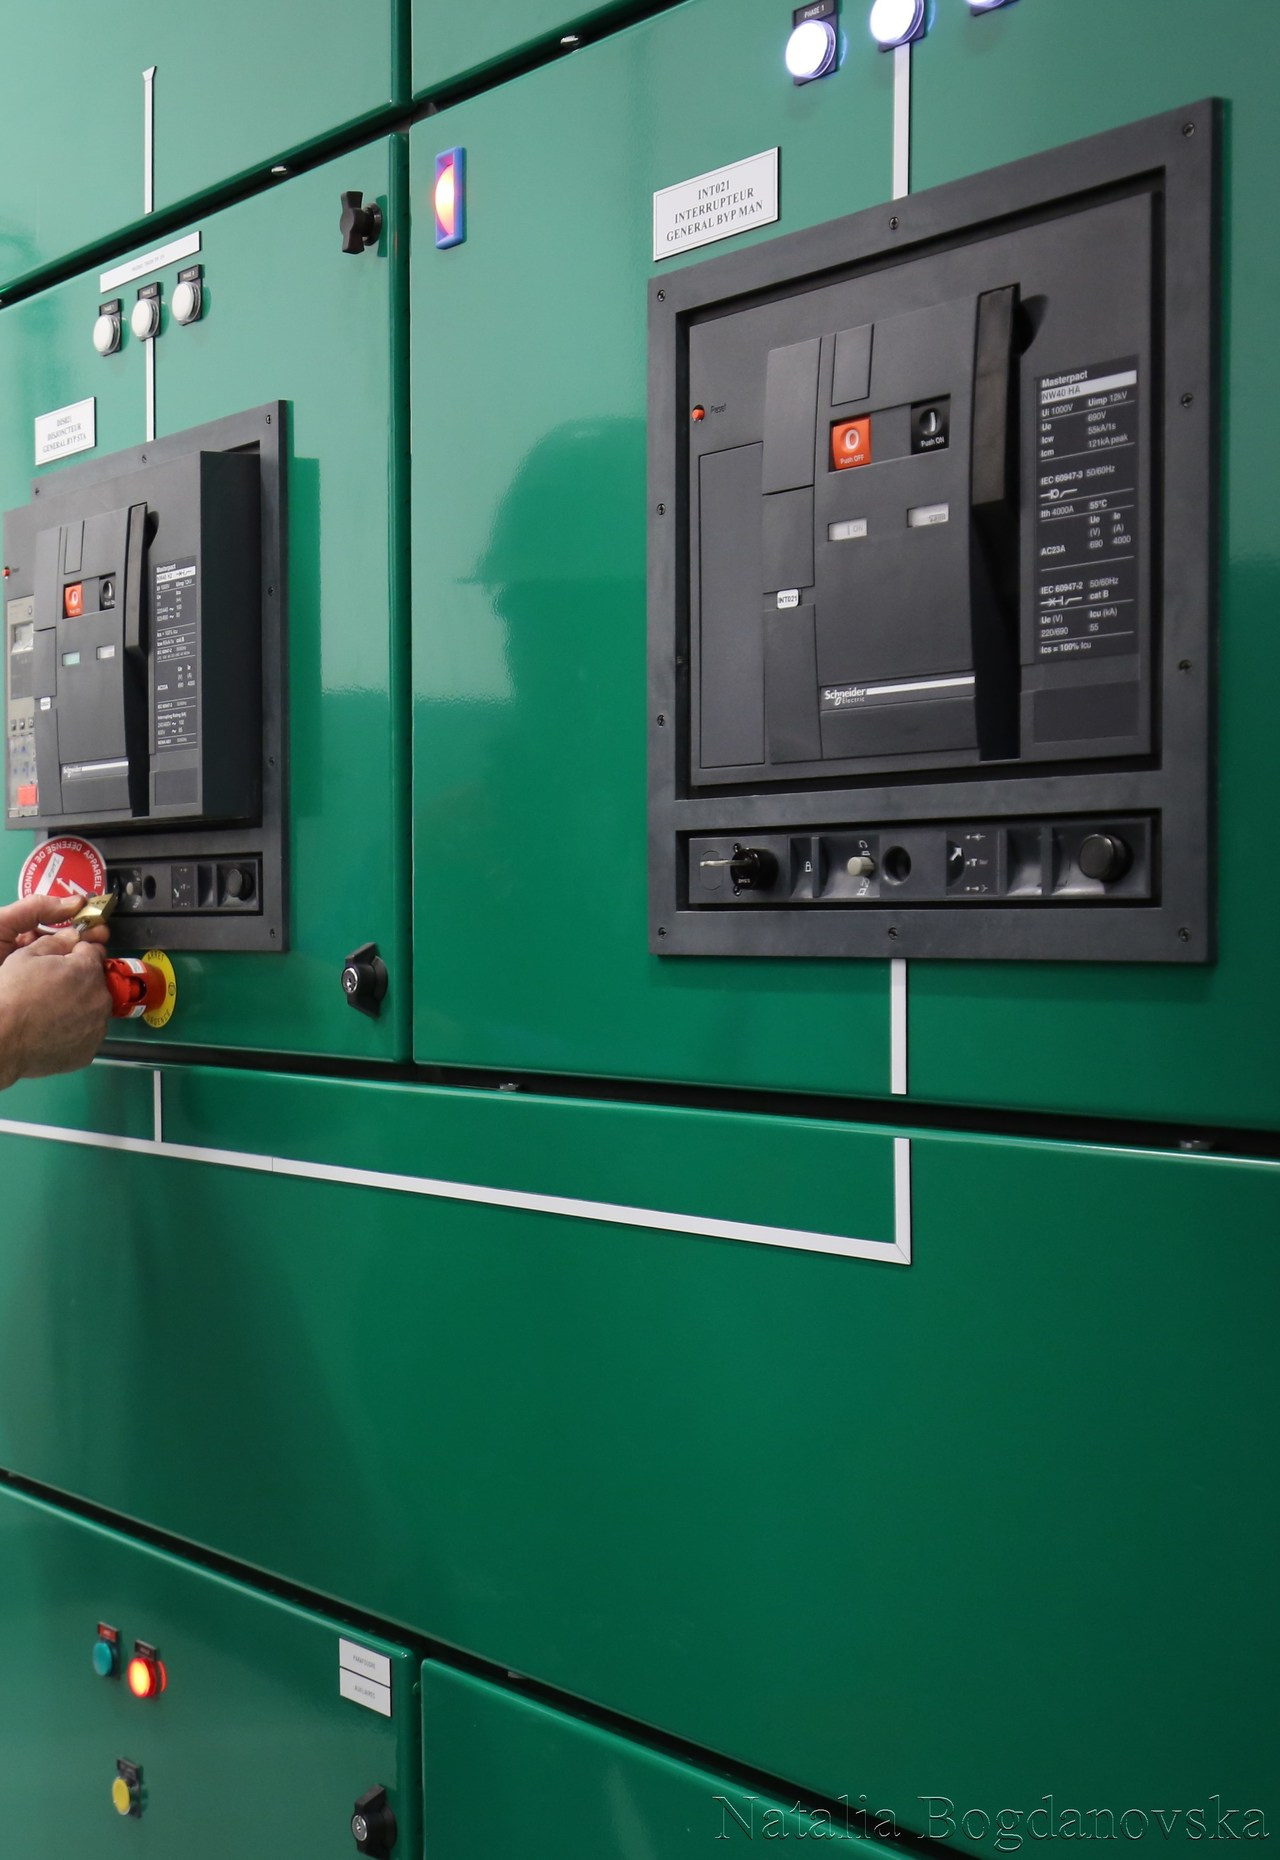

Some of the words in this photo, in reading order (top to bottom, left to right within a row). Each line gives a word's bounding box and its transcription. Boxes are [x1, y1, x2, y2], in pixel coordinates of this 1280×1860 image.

[804, 7, 820, 18] PHASE
[698, 180, 730, 200] INT021
[675, 188, 754, 224] INTERRUPTEUR
[666, 217, 714, 242] GENERAL
[716, 209, 736, 225] BYP
[739, 200, 763, 216] MAN
[1042, 370, 1088, 388] Masterpact
[1042, 389, 1066, 401] NW40
[1068, 386, 1081, 395] HA
[1042, 409, 1050, 417] Ui
[1051, 404, 1074, 415] 1000V
[1088, 397, 1108, 407] Uimp
[1110, 391, 1128, 402] 12kV
[1042, 423, 1051, 431] Ue
[1088, 412, 1107, 421] 690V
[1088, 423, 1116, 435] 55kA/1s
[921, 437, 935, 448] Push
[935, 436, 945, 445] ON
[840, 456, 854, 465] Push
[854, 454, 865, 463] OFF
[1041, 449, 1054, 457] Icm
[1040, 476, 1054, 486] IEC
[1055, 471, 1083, 483] 60947-3
[1086, 465, 1115, 477] 50/60Hz
[1052, 505, 1074, 515] 4000A
[1089, 499, 1108, 509] 55°C
[1090, 516, 1100, 524] Ue
[1089, 528, 1101, 538] (V)
[1113, 523, 1124, 533] (A)
[1090, 539, 1104, 549] 690
[1113, 535, 1131, 545] 4000
[1040, 545, 1066, 556] AC23A
[1041, 586, 1054, 595] IEC
[1055, 582, 1083, 593] 60947-2
[1090, 577, 1119, 588] 50/60Hz
[778, 595, 798, 604] INT021
[1090, 591, 1101, 600] cat
[1103, 590, 1109, 598] B
[1041, 616, 1052, 624] Ue
[1052, 614, 1063, 623] (V)
[1090, 610, 1102, 619] Icu
[1103, 607, 1118, 618] (kA)
[1040, 627, 1069, 638] 220/690
[1090, 623, 1099, 632] 55
[1041, 646, 1052, 654] Ics
[1060, 642, 1080, 651] 100%
[824, 687, 866, 700] Schneider
[842, 696, 865, 704] Electric
[34, 850, 47, 865] DE
[83, 850, 102, 889] APPAREIL
[24, 862, 38, 898] MANOE
